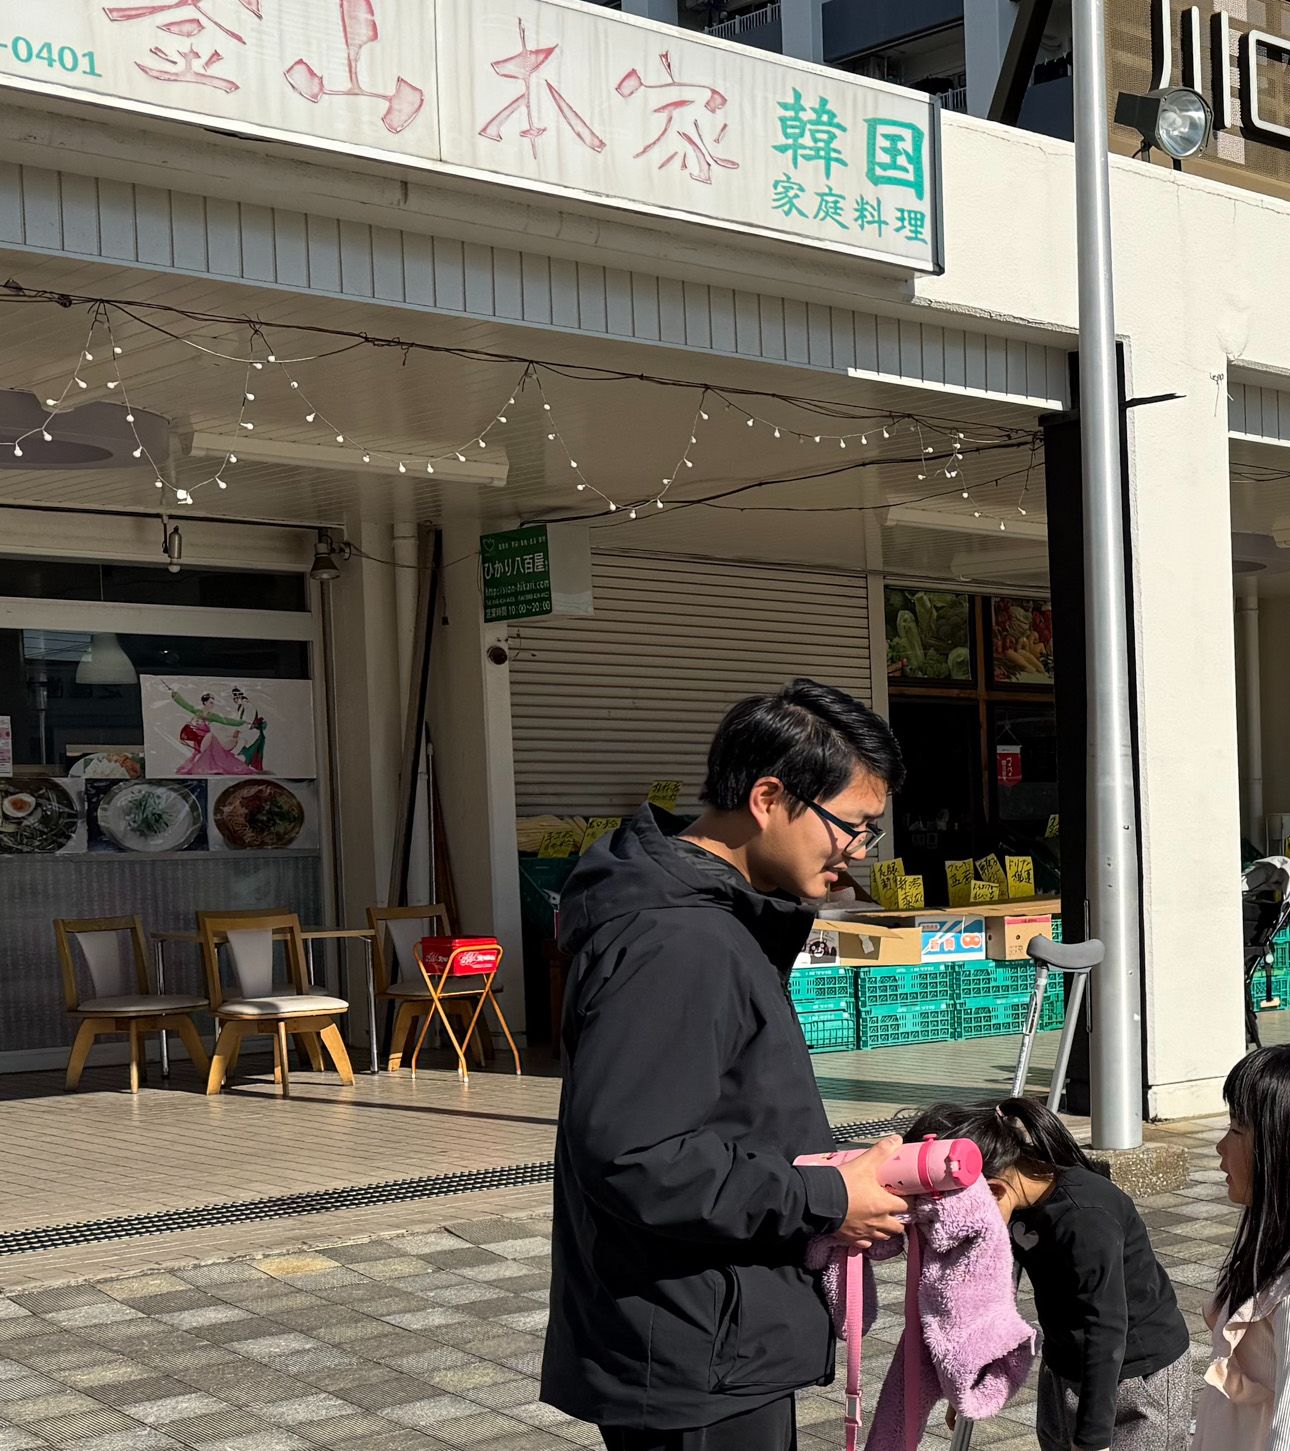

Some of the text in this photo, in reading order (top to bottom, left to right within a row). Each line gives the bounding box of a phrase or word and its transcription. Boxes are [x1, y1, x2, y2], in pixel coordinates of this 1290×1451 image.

[771, 87, 926, 201] 韓国
[770, 172, 928, 245] 家庭料理
[483, 552, 545, 580] ひかり八百屋
